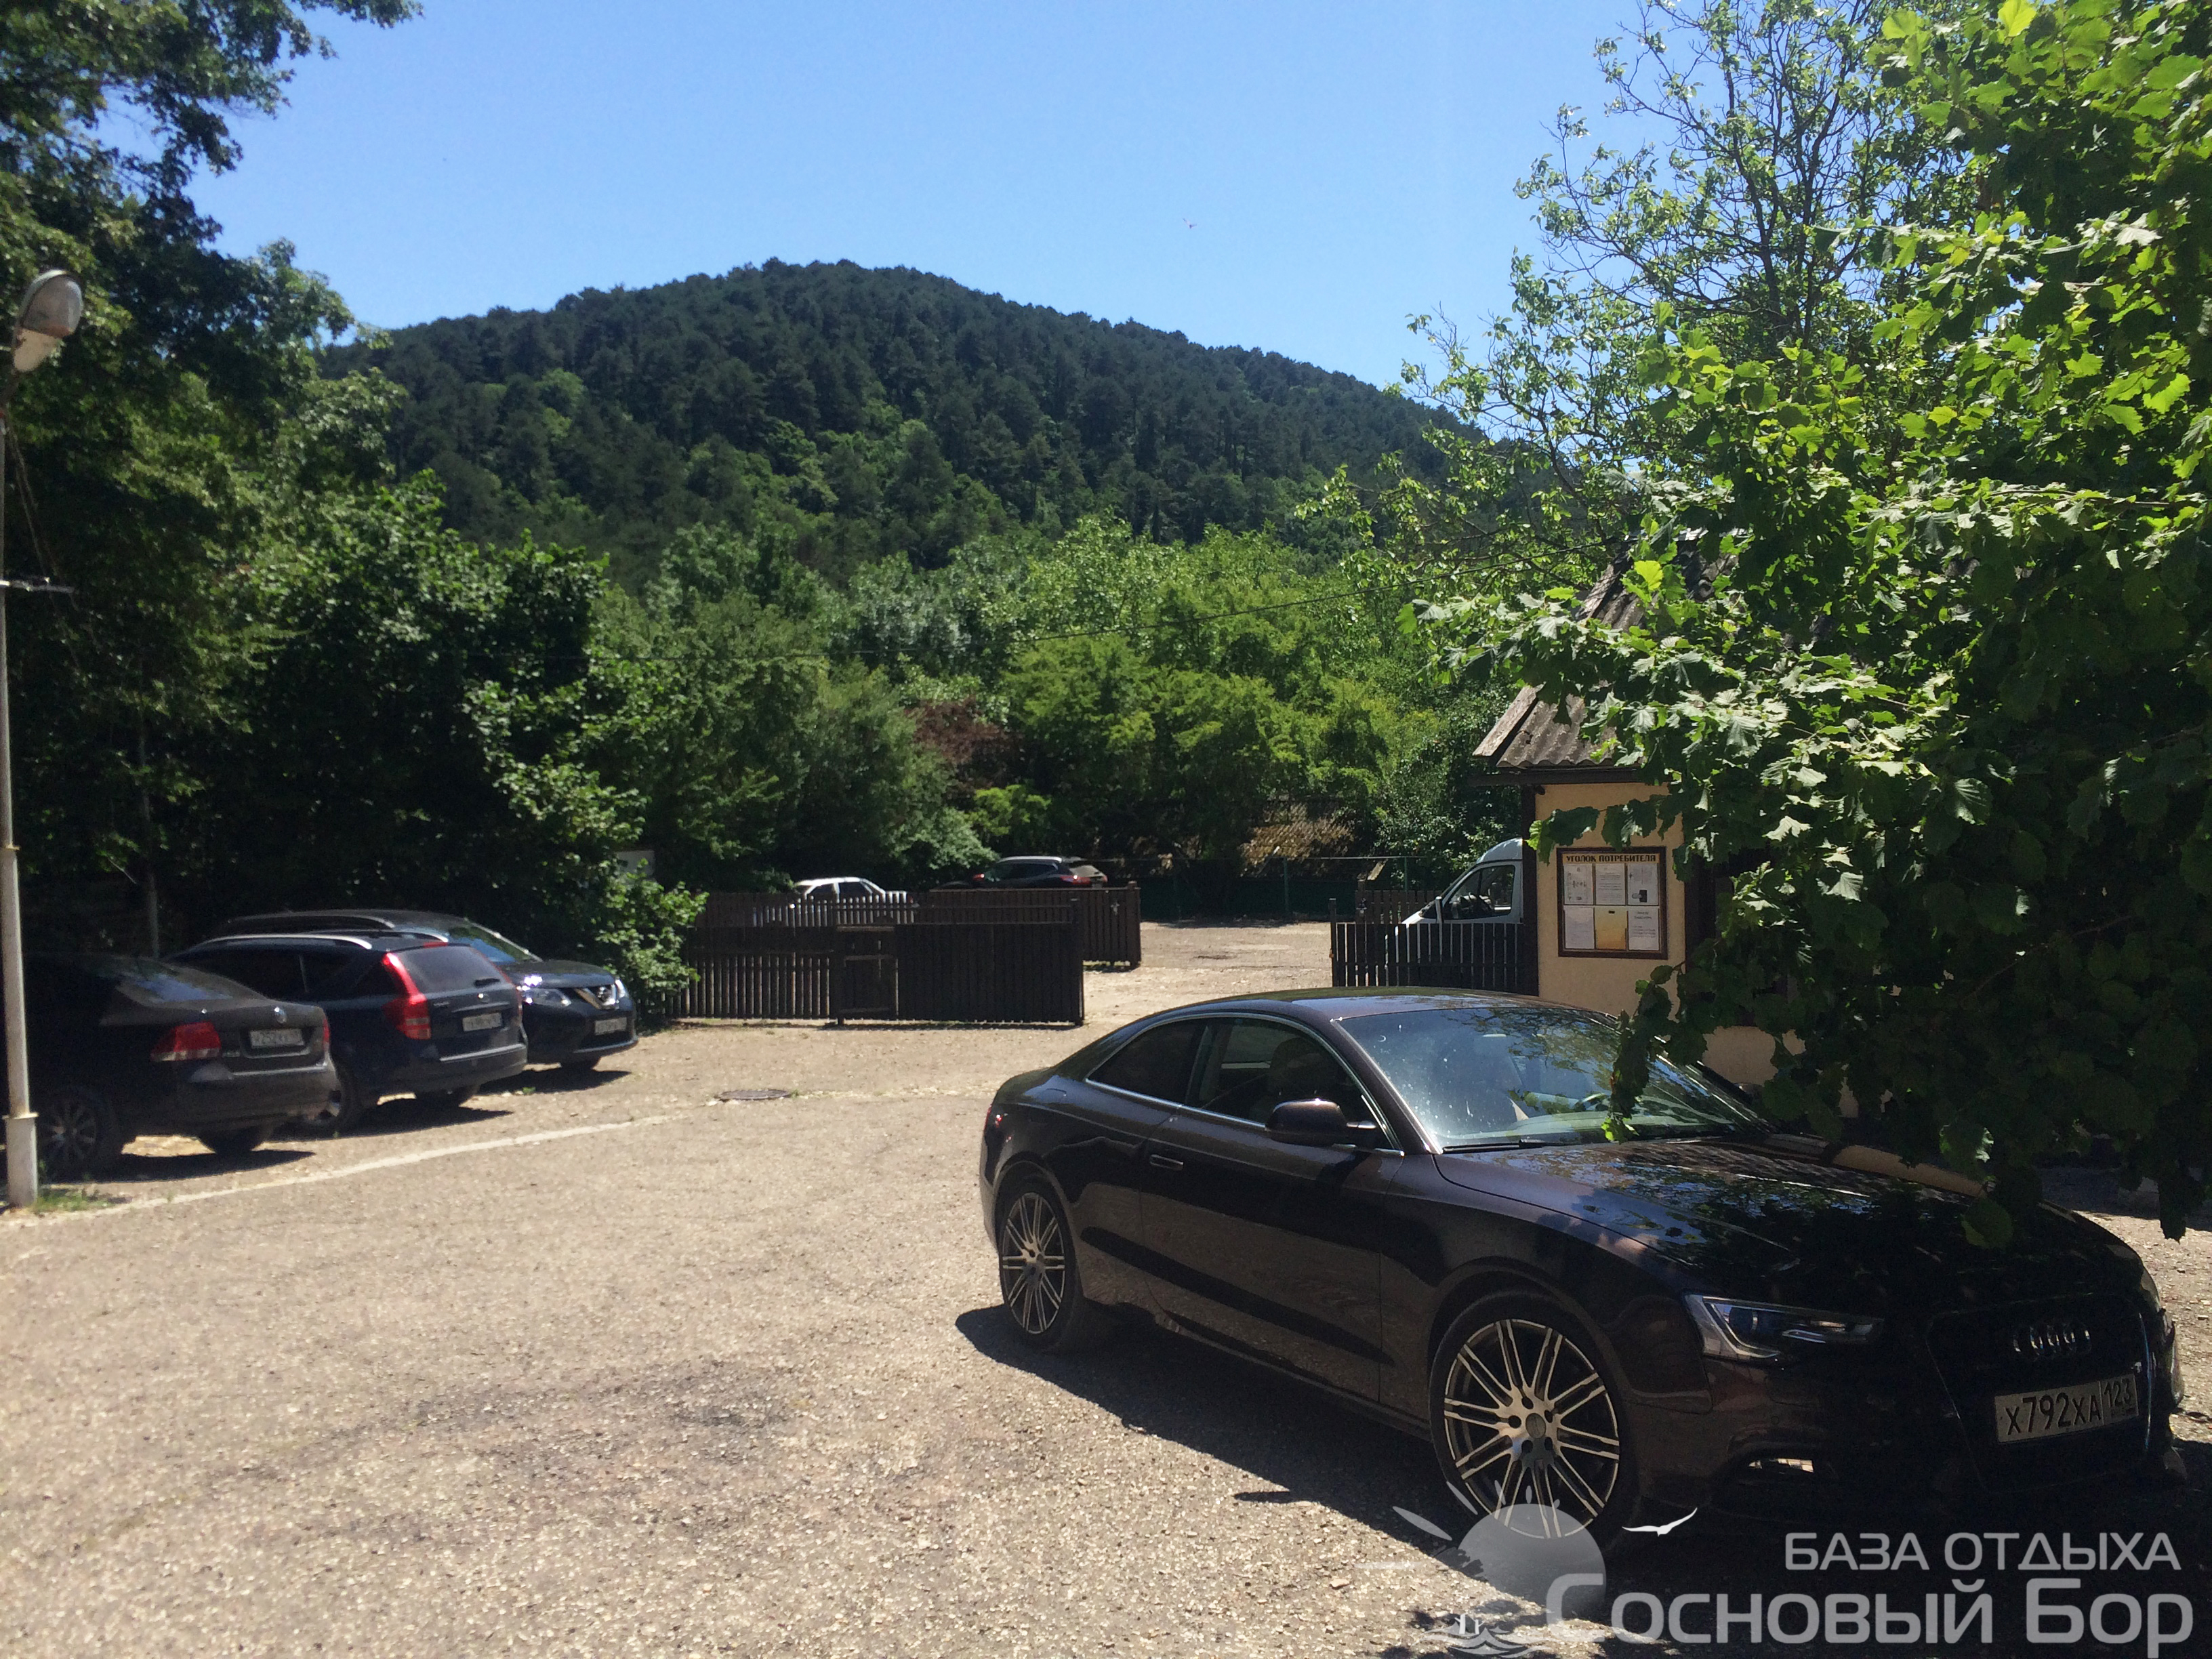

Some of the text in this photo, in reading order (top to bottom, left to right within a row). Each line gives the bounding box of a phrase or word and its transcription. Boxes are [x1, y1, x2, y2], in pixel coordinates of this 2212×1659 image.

[1565, 855, 1656, 863] УГОЛОК ПОТРЕБИТЕЛЯ
[2104, 1378, 2133, 1408] 123
